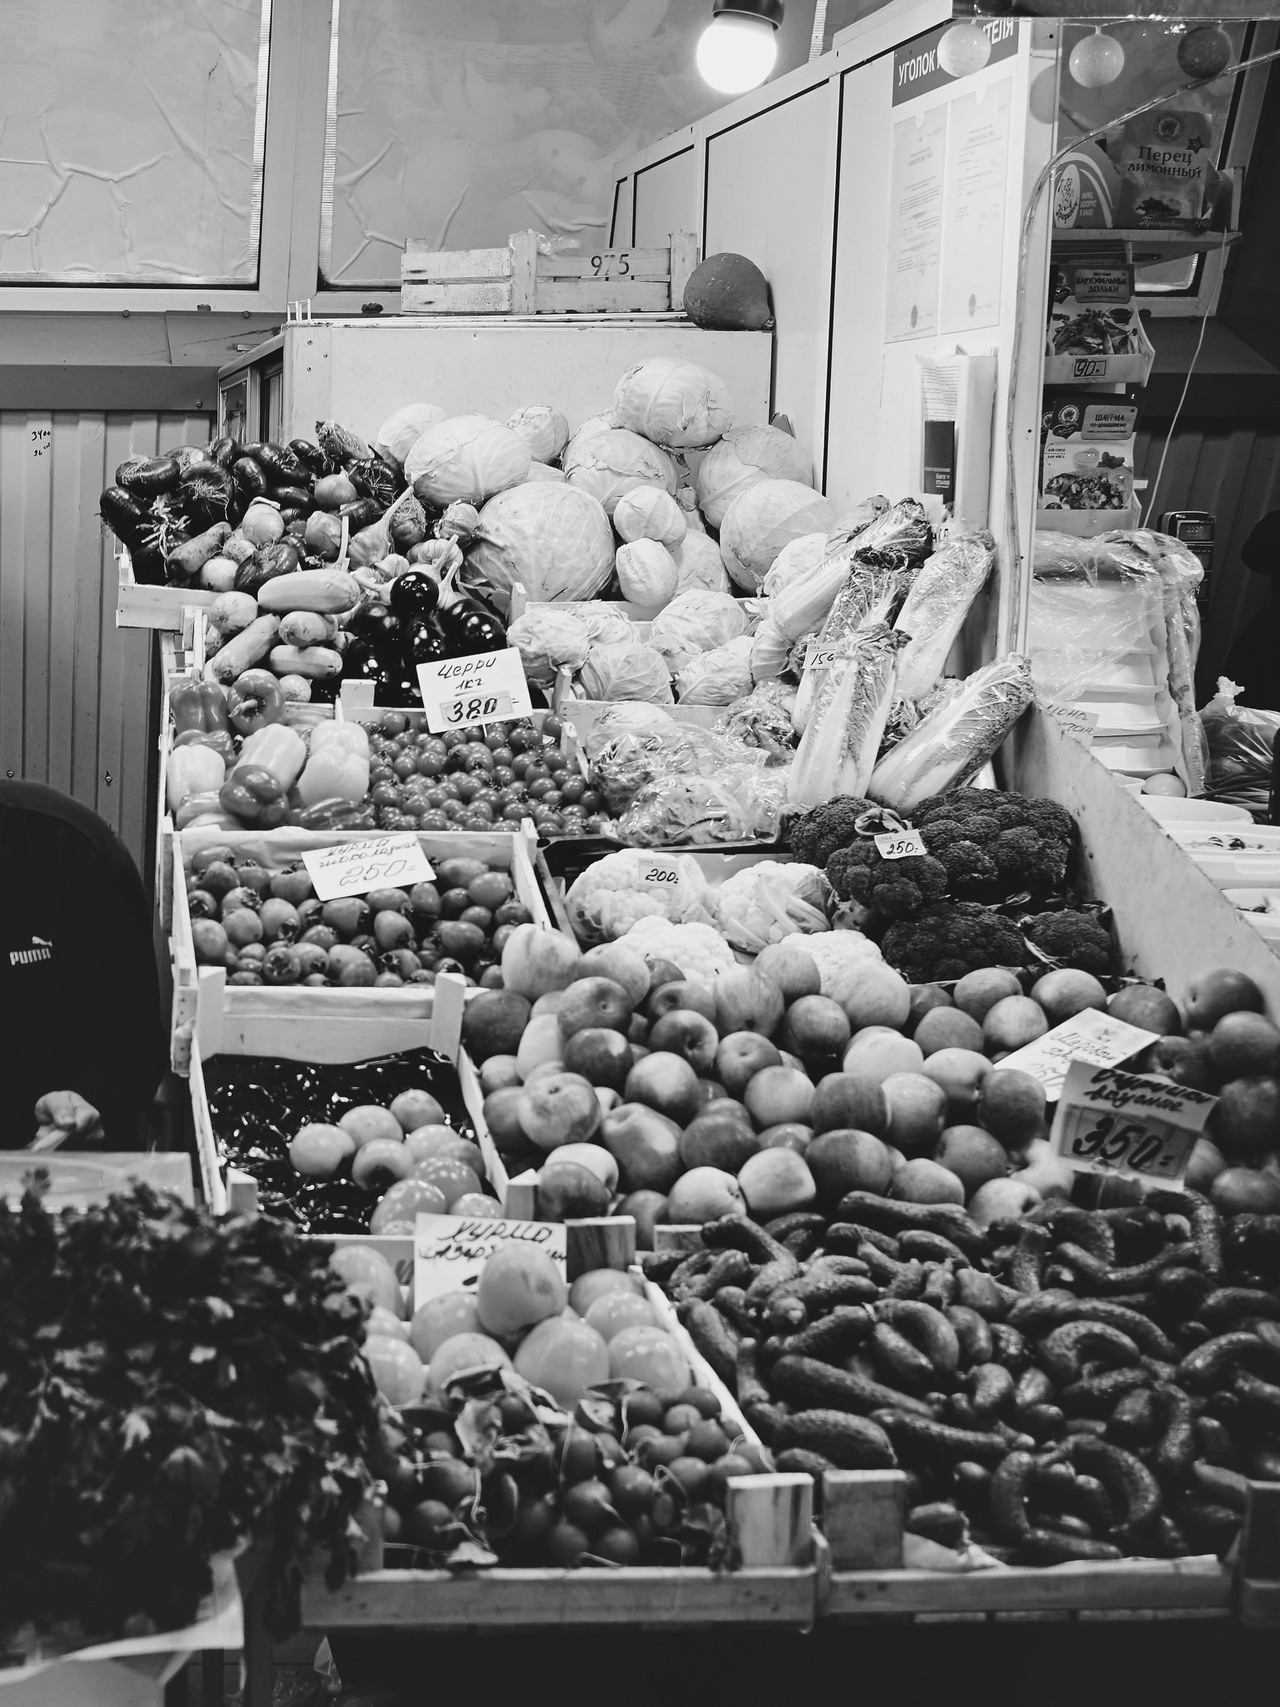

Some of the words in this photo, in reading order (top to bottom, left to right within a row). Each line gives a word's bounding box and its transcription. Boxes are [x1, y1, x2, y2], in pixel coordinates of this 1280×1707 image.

[898, 49, 936, 87] УГОЛОК
[1138, 146, 1193, 166] Перец
[1088, 285, 1119, 293] ДОЛЬКИ
[1094, 413, 1125, 422] ШАУРМА
[9, 947, 51, 966] PUMA
